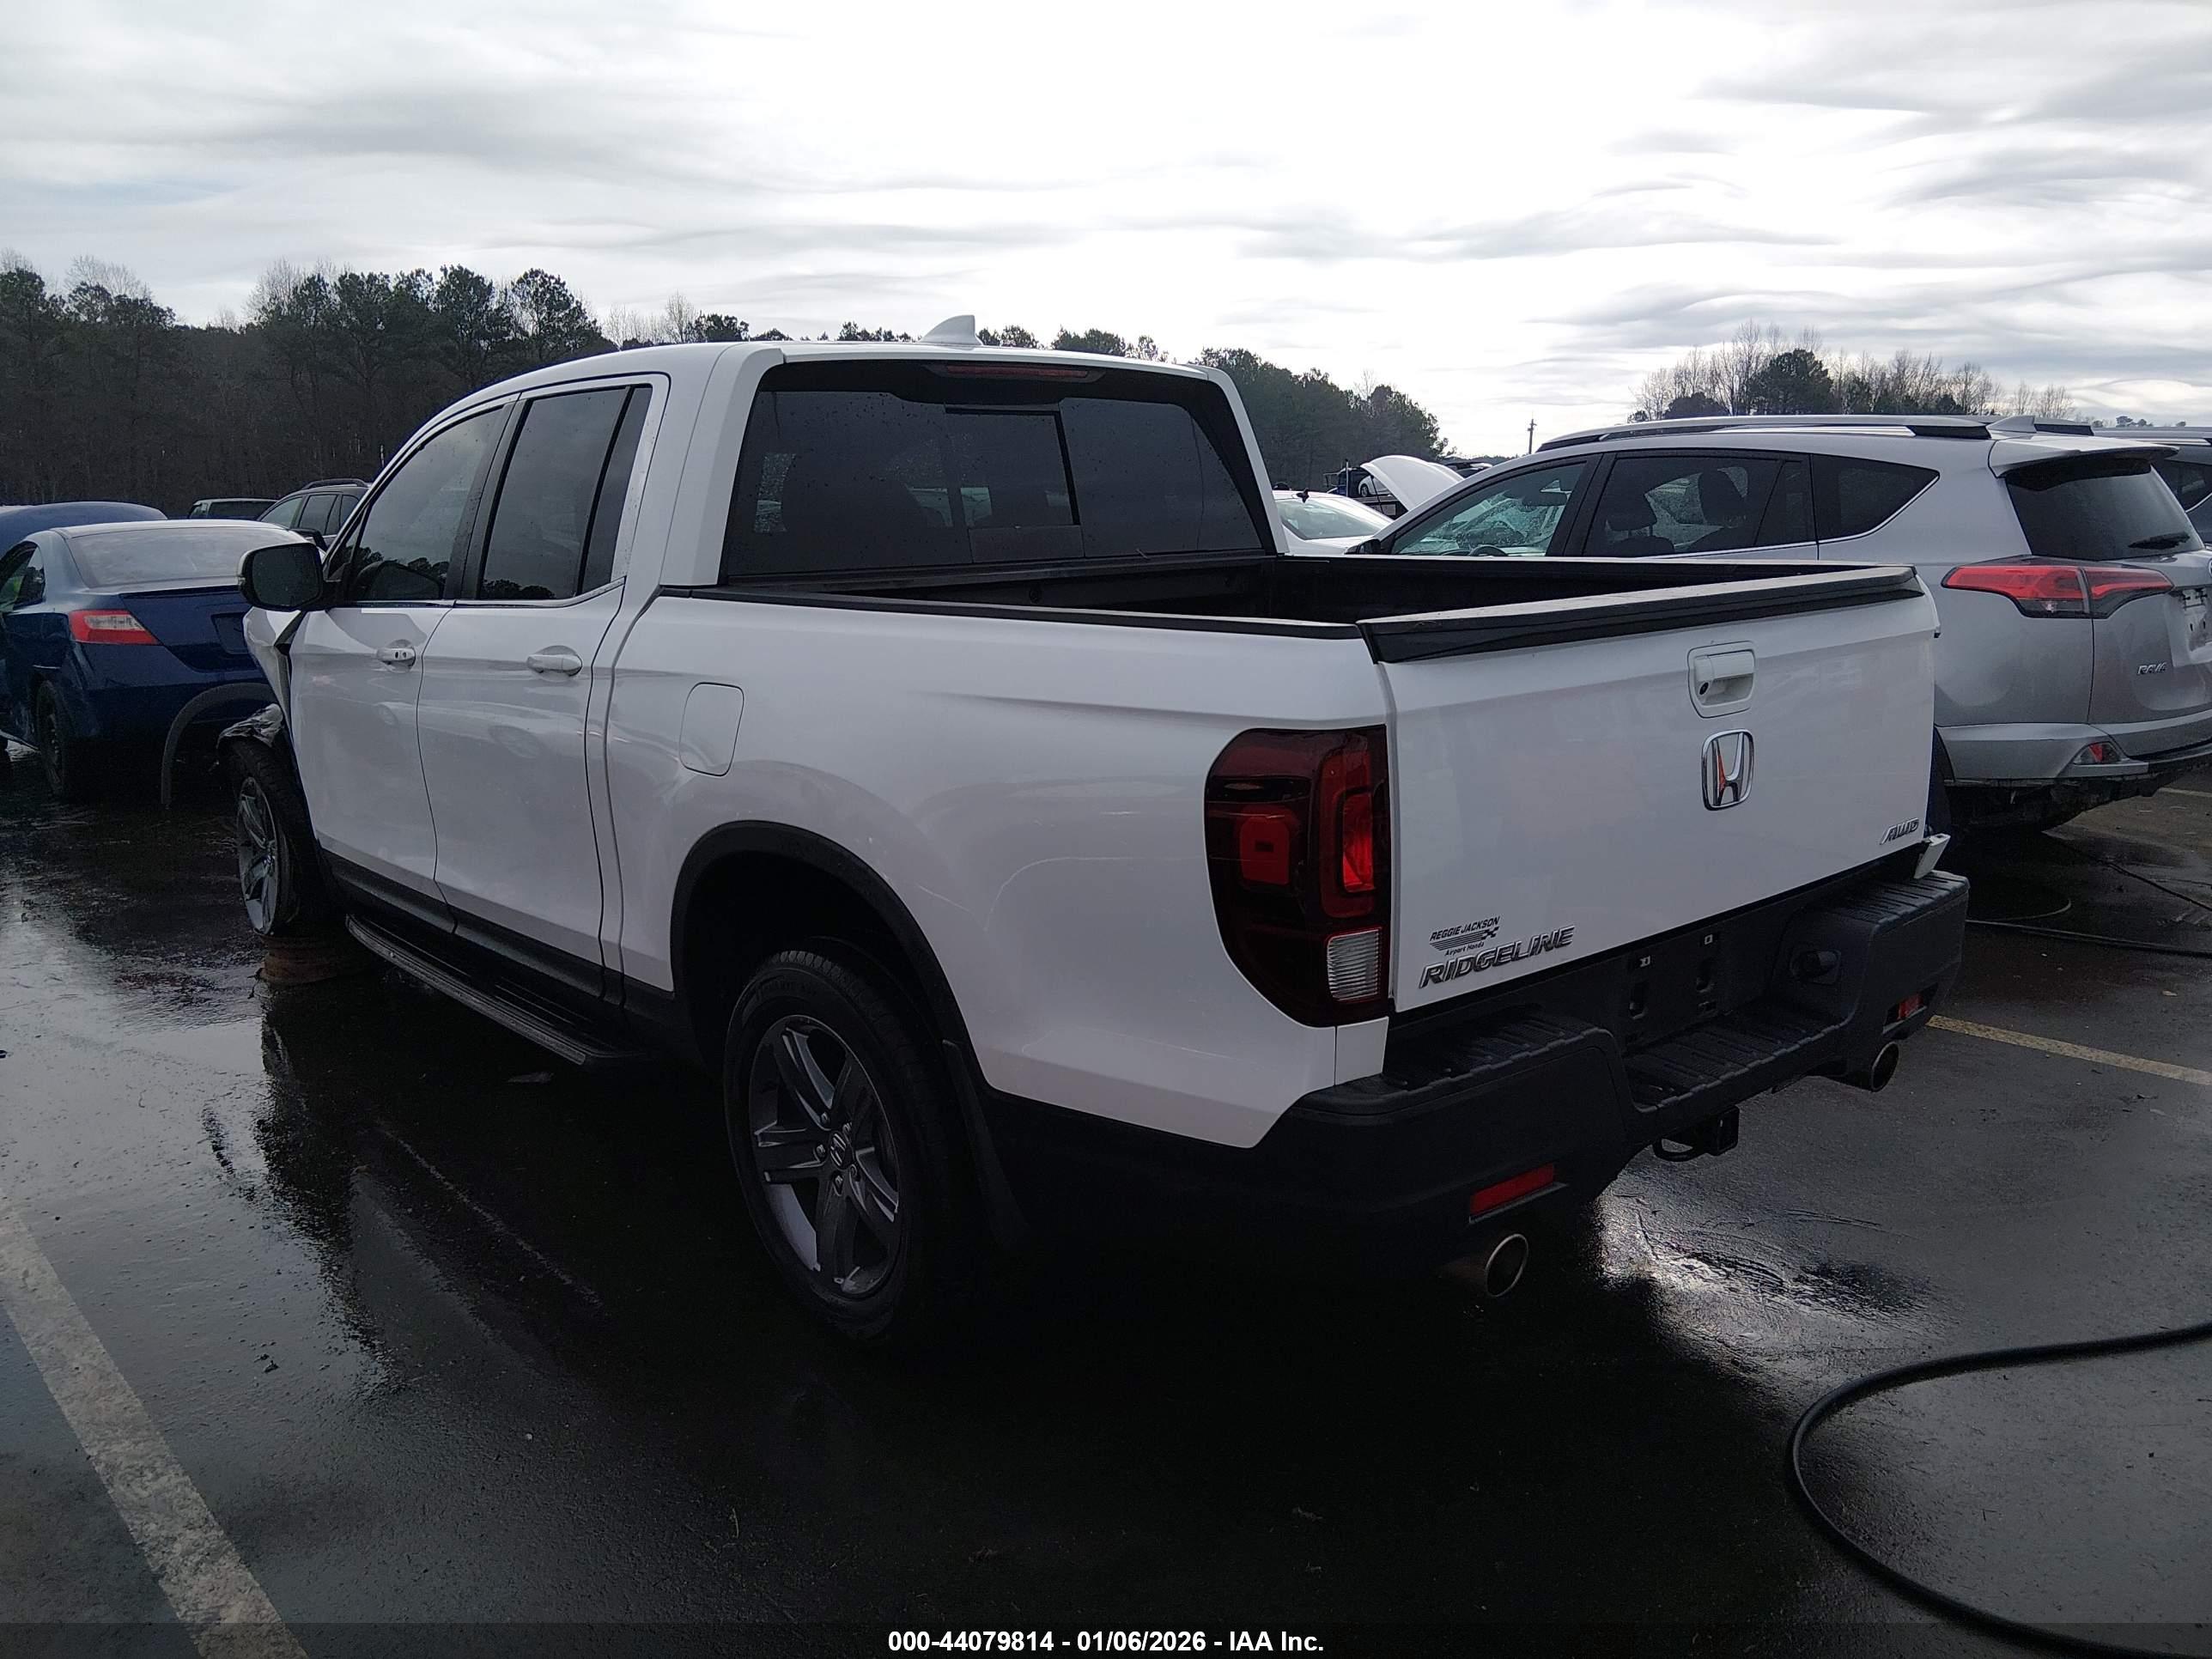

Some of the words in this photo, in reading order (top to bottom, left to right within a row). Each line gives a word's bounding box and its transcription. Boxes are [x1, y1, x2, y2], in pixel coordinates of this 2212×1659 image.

[1879, 817, 1919, 845] AWD
[1429, 925, 1462, 942] REGGIE
[1461, 915, 1501, 933] JACKSON
[1419, 925, 1575, 989] RIDGELINE
[1467, 941, 1485, 951] Honda
